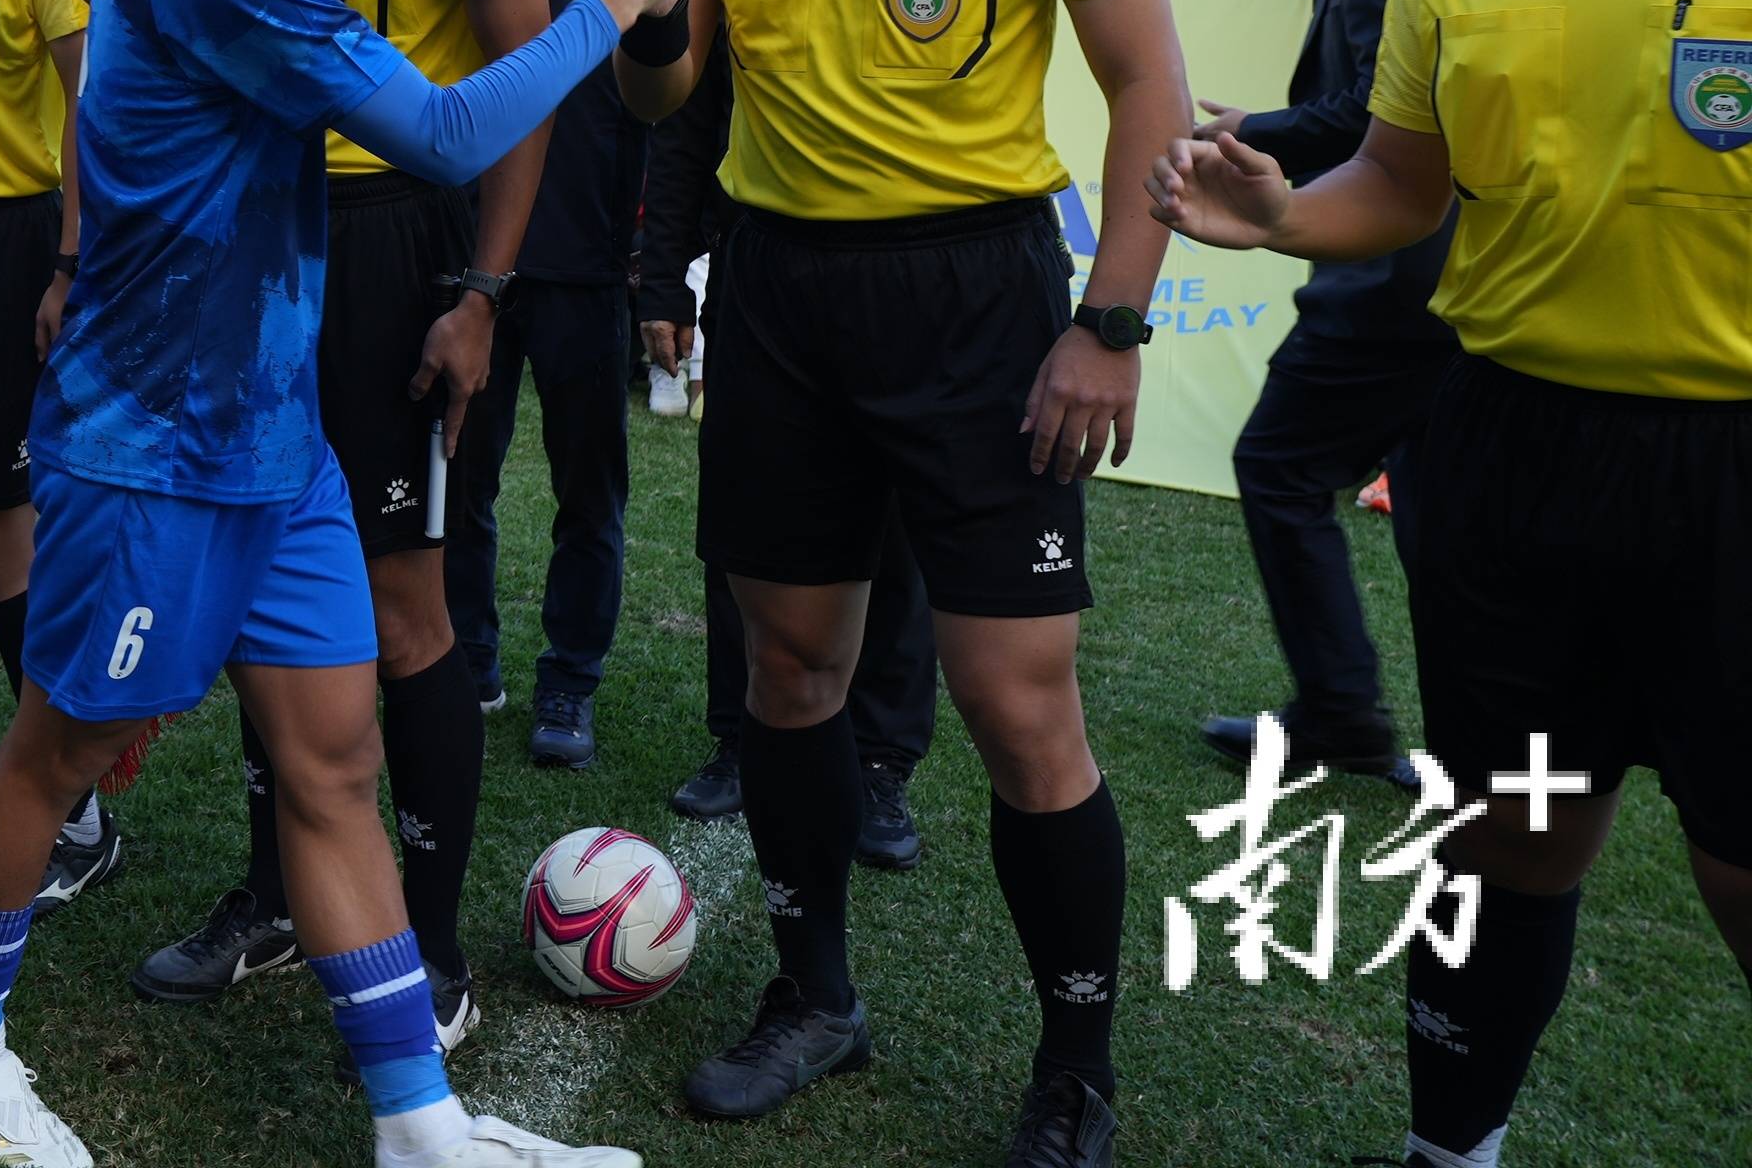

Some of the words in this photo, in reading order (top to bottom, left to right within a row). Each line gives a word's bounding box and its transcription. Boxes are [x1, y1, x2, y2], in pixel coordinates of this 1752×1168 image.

[915, 3, 931, 11] CFA
[381, 497, 420, 515] KELME
[1032, 558, 1074, 574] KELME
[108, 606, 154, 680] 6
[1054, 988, 1108, 1004] KELME
